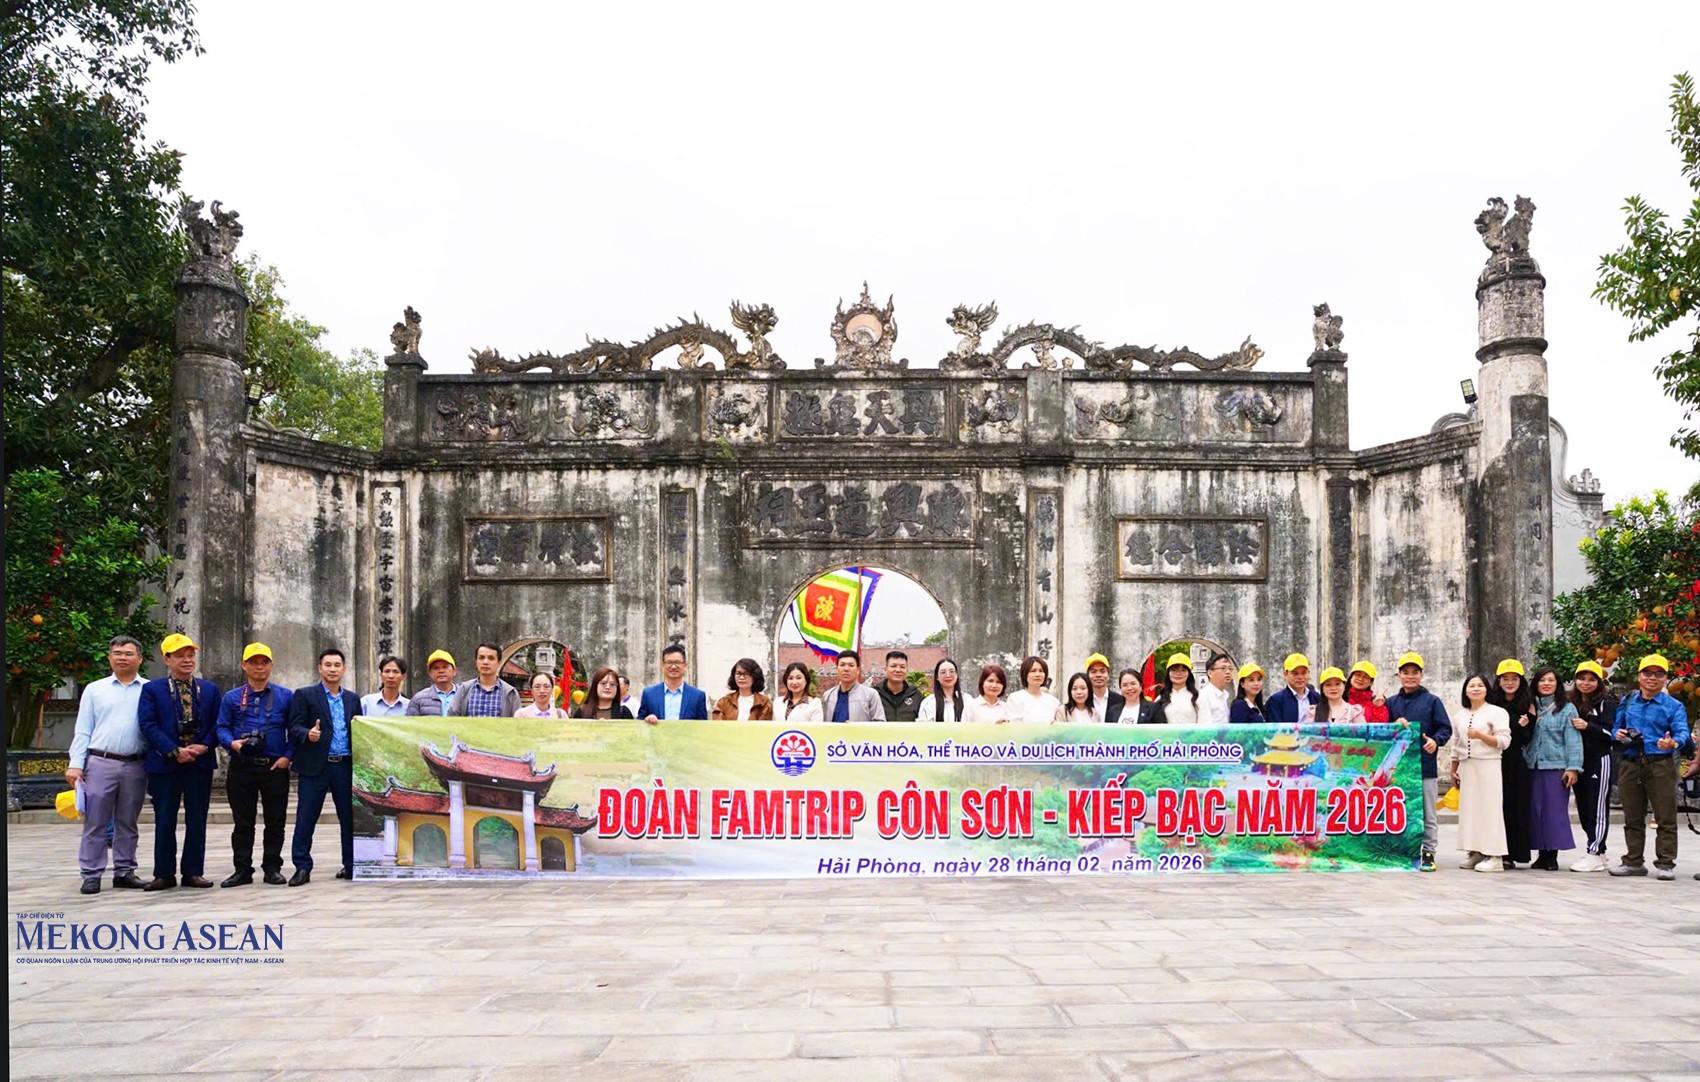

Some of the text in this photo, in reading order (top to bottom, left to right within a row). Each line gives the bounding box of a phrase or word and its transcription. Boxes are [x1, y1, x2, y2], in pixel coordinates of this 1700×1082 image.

[827, 739, 1242, 760] SỞ VĂN HÓA, THỂ THAO VÀ DU LỊCH THÀNH PHỐ HẢI PHÒNG
[597, 774, 1406, 845] ĐOÀN FAMTRIP CÔN SƠN - KIẾP BẠC NĂM 2026
[817, 857, 851, 874] Hải
[933, 857, 981, 876] ngày
[988, 857, 1009, 873] 28
[1016, 856, 1071, 874] tháng
[1077, 856, 1100, 872] 02
[1111, 856, 1152, 871] năm
[1159, 855, 1202, 870] 2026
